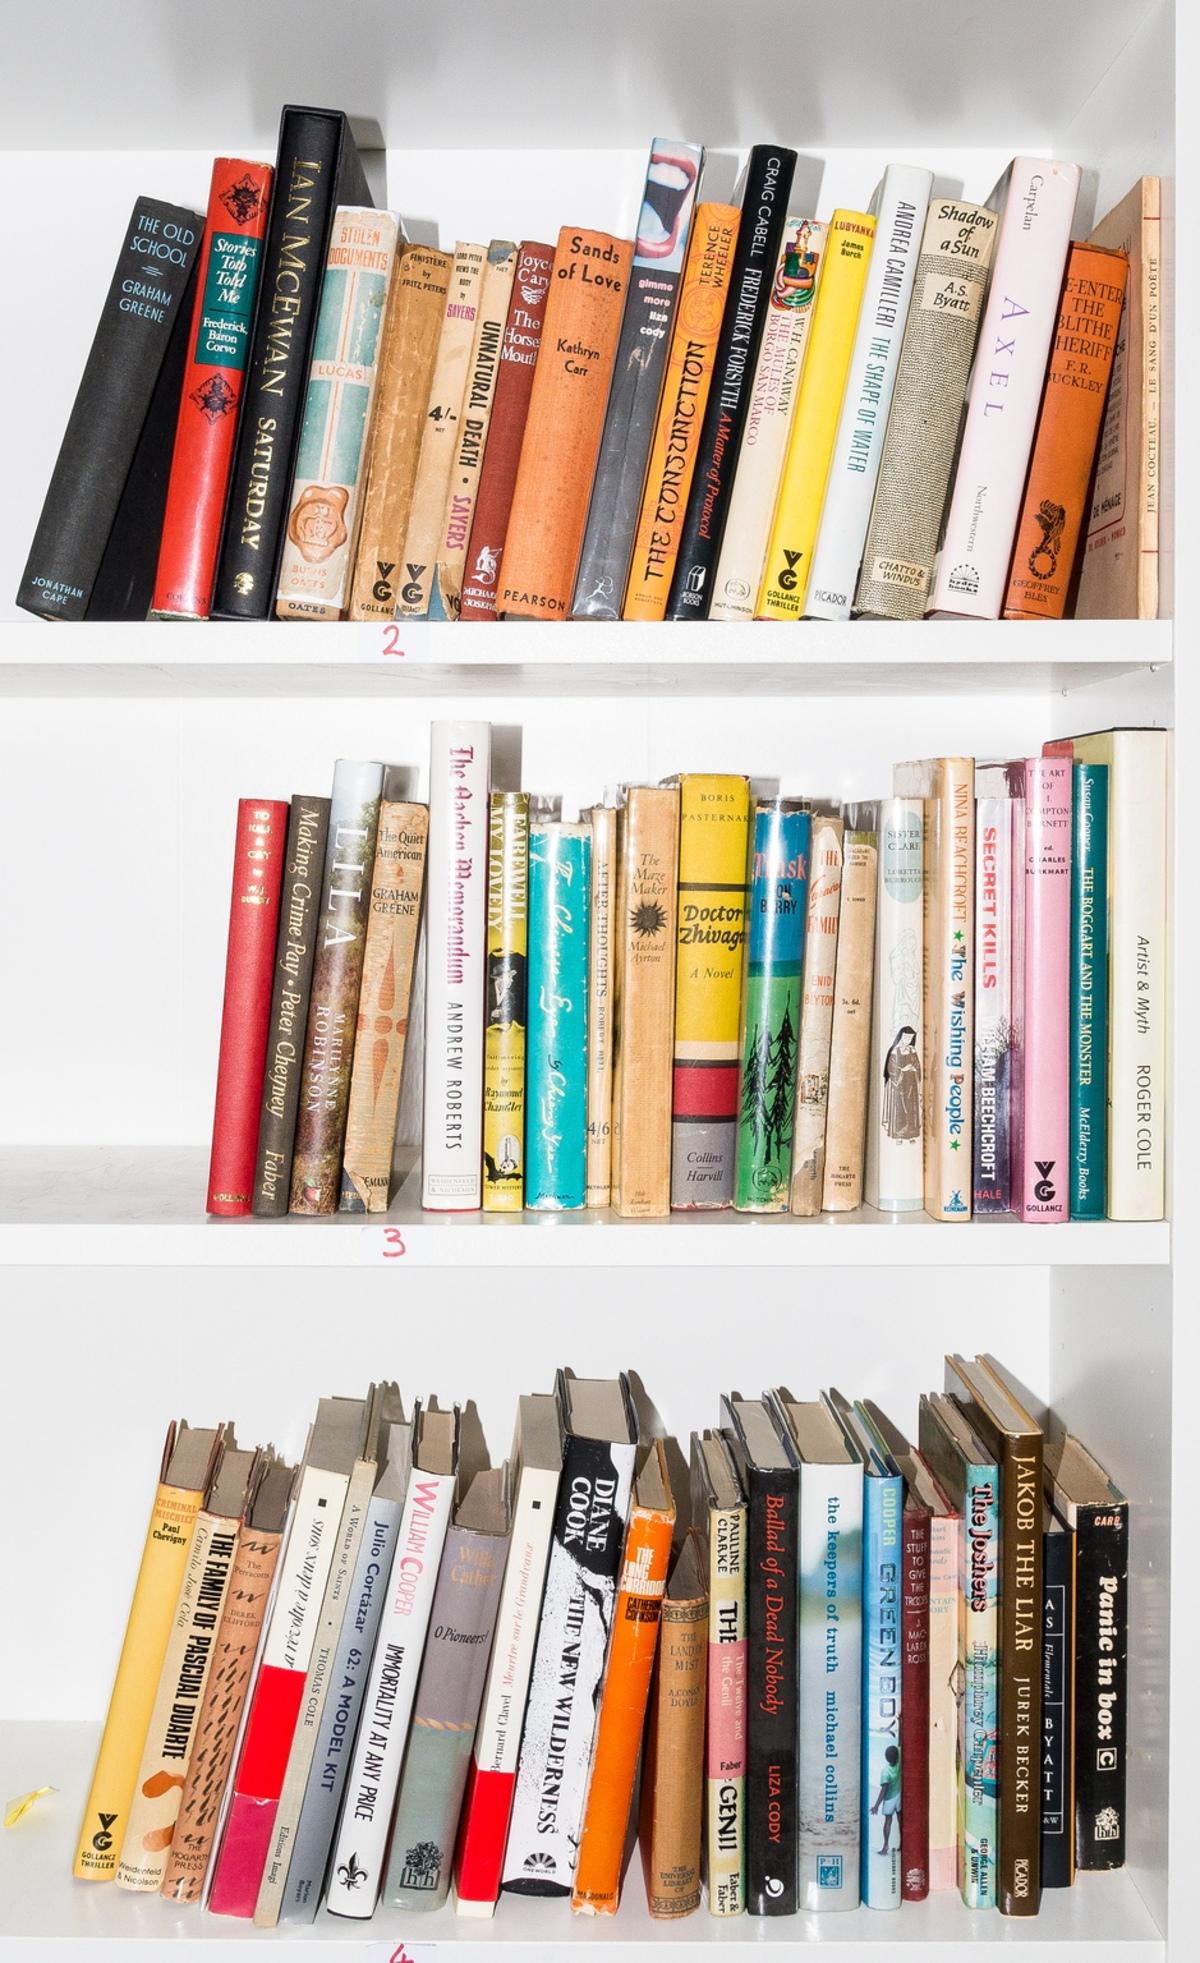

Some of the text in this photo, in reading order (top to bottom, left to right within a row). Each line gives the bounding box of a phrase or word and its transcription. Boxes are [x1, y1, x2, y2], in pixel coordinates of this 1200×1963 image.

[1022, 174, 1044, 231] Carpelan
[938, 205, 994, 230] Shadow
[138, 215, 195, 246] THE OLD
[130, 236, 187, 268] SCHOOL
[214, 238, 257, 258] Stories
[571, 236, 620, 264] Sands
[700, 226, 720, 285] TERENCE
[841, 239, 864, 251] James
[841, 248, 862, 259] Burch
[950, 240, 980, 259] Sun
[712, 227, 733, 289] WHEELER
[402, 279, 421, 290] FRITZ
[582, 264, 622, 292] Love
[639, 279, 673, 292] gimme
[122, 280, 172, 306] GRAHAM
[217, 288, 240, 304] Me
[644, 295, 670, 307] more
[933, 293, 970, 312] Byatt
[120, 298, 165, 324] GREENE
[447, 304, 476, 321] SAYERS
[1072, 297, 1104, 318] THE
[514, 309, 540, 329] The
[208, 330, 238, 344] Baron
[640, 326, 665, 338] cody
[847, 201, 916, 473] ANDREA CAMILLERI THE SHAPE WATER
[206, 341, 237, 355] Corvo
[241, 157, 322, 551] IAN SATURDAY
[557, 339, 600, 360] Kathryn
[698, 157, 781, 540] CRAIG CABELL FREDERICK FORSYTH Protocol
[318, 366, 363, 380] LUCAS
[565, 360, 588, 376] Carr
[747, 314, 780, 446] BORGO MARCO
[459, 320, 501, 468] UNNATURAL DEATH
[1147, 483, 1156, 513] JEAN
[446, 495, 470, 551] SAYERS
[878, 560, 916, 576] CHATTO
[31, 577, 83, 599] JONATHAN
[882, 571, 921, 587] WINDUS
[1013, 579, 1060, 595] GEOFFREY
[42, 591, 68, 605] CAPE
[504, 590, 565, 611] PEARSON
[767, 589, 800, 604] GOLLANCZ
[814, 590, 848, 607] PICADOR
[1024, 591, 1048, 603] BLES
[288, 602, 326, 615] OATES
[382, 624, 405, 657] 2
[376, 848, 423, 861] American
[324, 823, 368, 950] LILA
[373, 886, 419, 902] GRAHAM
[631, 882, 668, 896] Maker
[372, 902, 416, 916] GREENE
[684, 905, 742, 922] Doctor
[983, 827, 997, 989] SECRET KILLS
[630, 941, 666, 951] Michael
[631, 953, 661, 963] Ayrton
[946, 783, 968, 1135] NINA BEACHCROFT Wishing People
[704, 968, 734, 979] Novel
[1079, 868, 1094, 1086] THE BOGGART AND THE MONSTER
[262, 808, 320, 1201] Making Crime Peter Cheyney Faber
[307, 1005, 329, 1113] ROBINSON
[1134, 935, 1152, 1170] Artist Myth ROGER COLE
[446, 1002, 463, 1150] ANDREW ROBERTS
[981, 1087, 996, 1180] BEECHCROFT
[687, 1152, 723, 1163] Collins
[687, 1170, 723, 1182] Harvill
[973, 1191, 1002, 1199] HALE
[1026, 1204, 1063, 1212] GOLLANCZ
[383, 1228, 406, 1258] 3
[563, 1476, 591, 1545] COOK
[586, 1477, 616, 1552] DIANE
[153, 1530, 187, 1546] Chevigny
[162, 1523, 180, 1534] Paul
[636, 1547, 655, 1565] THE
[718, 1518, 728, 1574] CLARKE
[906, 1543, 927, 1553] STUFF
[970, 1483, 993, 1613] The Joshers
[879, 1487, 897, 1667] COOPER GREEN
[908, 1569, 926, 1580] GIVE
[162, 1532, 236, 1760] THE FAMILY PASCUAL DUARTE
[320, 1520, 389, 1793] Julio Cortázar MODEL KIT
[354, 1480, 440, 1822] WILLIAM COOPER IMMORTALITY ANY PRICE
[824, 1496, 840, 1822] the keepers truth michael collins
[1097, 1576, 1118, 1741] panic in box
[760, 1495, 785, 1844] Ballad Dead Nobody LIZA CODY
[1013, 1456, 1036, 1898] JAKOB THE LIAR JUREK BECKER PICADOR
[304, 1647, 330, 1728] THOMAS COLE
[537, 1641, 581, 1834] NEW WILDERNESS
[81, 1851, 116, 1861] GOLLANCZ
[979, 1838, 989, 1870] GEORGE
[119, 1861, 162, 1876] Weidenfeld
[174, 1861, 204, 1872] PRESS
[123, 1874, 159, 1886] Nicolson
